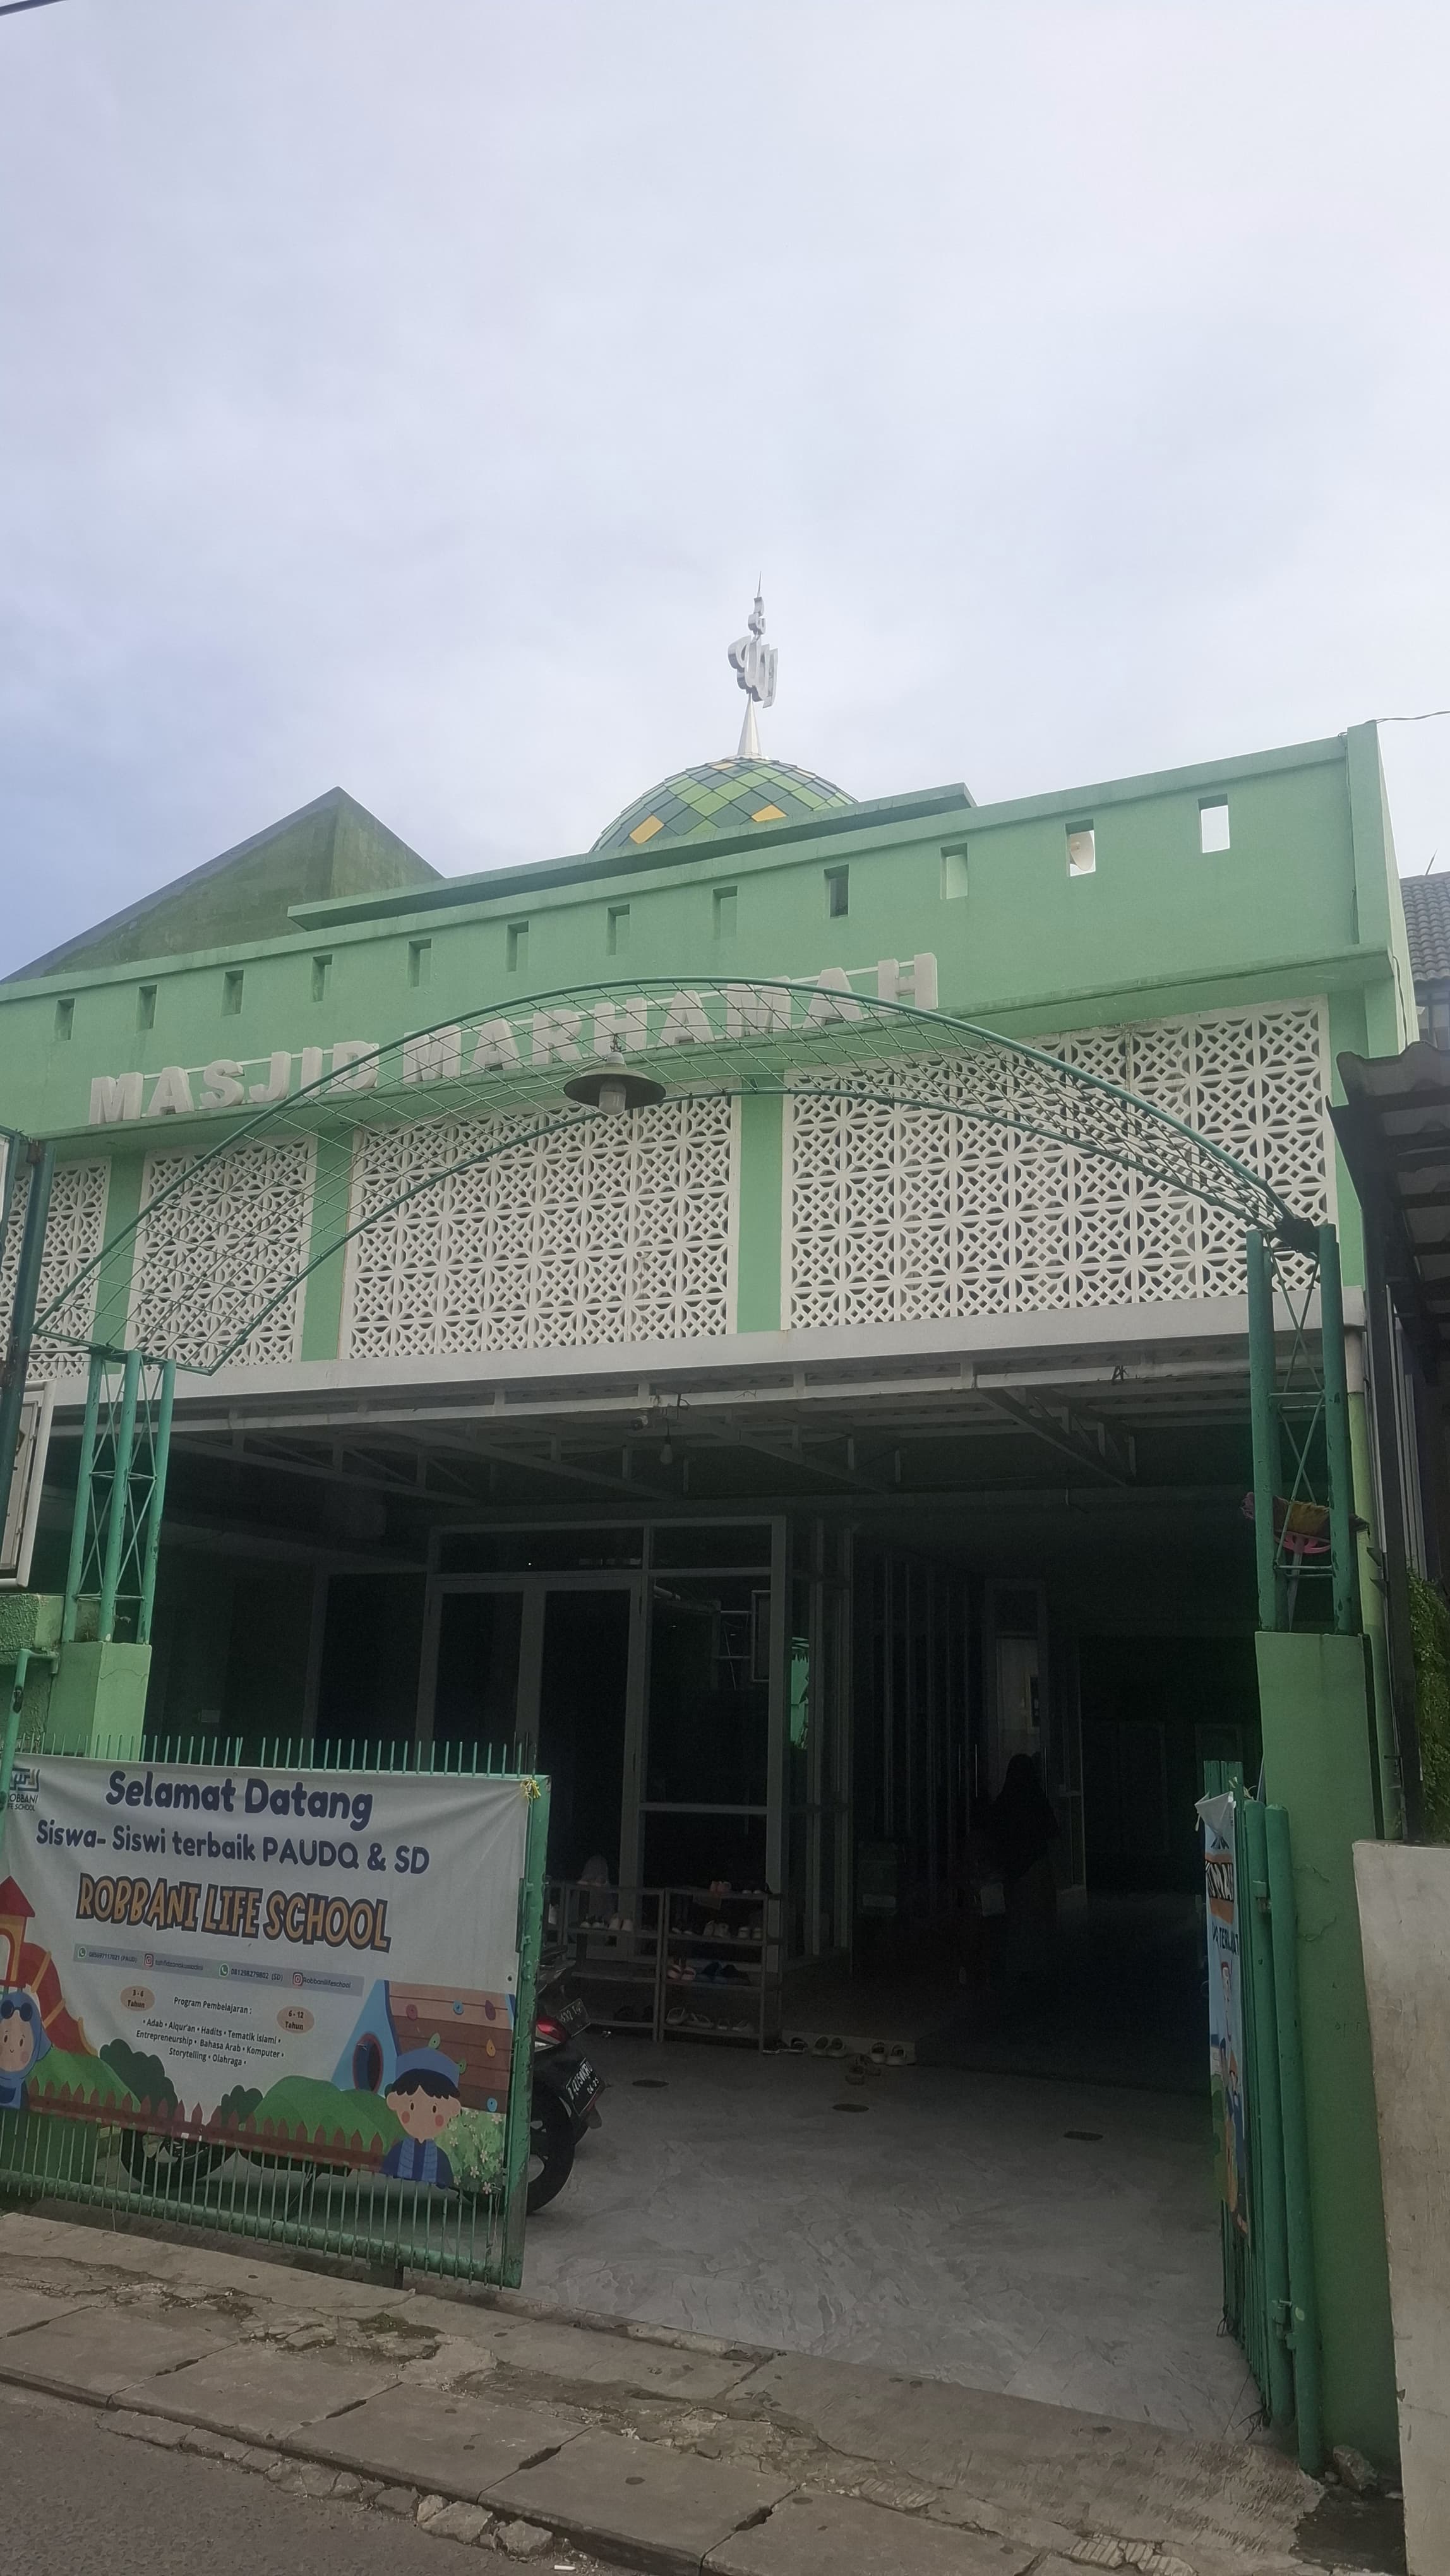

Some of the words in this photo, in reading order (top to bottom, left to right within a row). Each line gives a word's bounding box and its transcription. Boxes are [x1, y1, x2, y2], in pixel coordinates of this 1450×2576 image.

[89, 1041, 379, 1124] MASJID
[403, 953, 938, 1082] MARHAMAH
[9, 1793, 39, 1804] OBBANI
[106, 1770, 236, 1812] Selamat
[244, 1778, 373, 1831] Datang
[112, 1824, 166, 1854] Siswi
[172, 1831, 256, 1861] terbaik
[263, 1836, 359, 1869] PAUDQ
[367, 1842, 386, 1871] &
[394, 1845, 430, 1875] SD
[76, 1873, 202, 1932] ROBBANI
[201, 1883, 263, 1939] LIFE
[263, 1890, 392, 1953] SCHOOL
[271, 1974, 284, 1982] (SD)
[127, 2000, 145, 2008] Tahun
[174, 1996, 201, 2008] Program
[203, 2000, 248, 2014] Pembelajaran
[146, 2018, 164, 2028] Adab
[201, 2025, 222, 2037] Hadits
[227, 2029, 255, 2041] Tematik
[285, 2021, 304, 2030] Tahun
[136, 2030, 193, 2047] Entrepreneurship
[200, 2039, 224, 2050] Bahasa
[225, 2042, 241, 2053] Arab
[246, 2045, 280, 2059] Komputer
[169, 2047, 207, 2063] Storytelling
[212, 2054, 243, 2067] Olahraga
